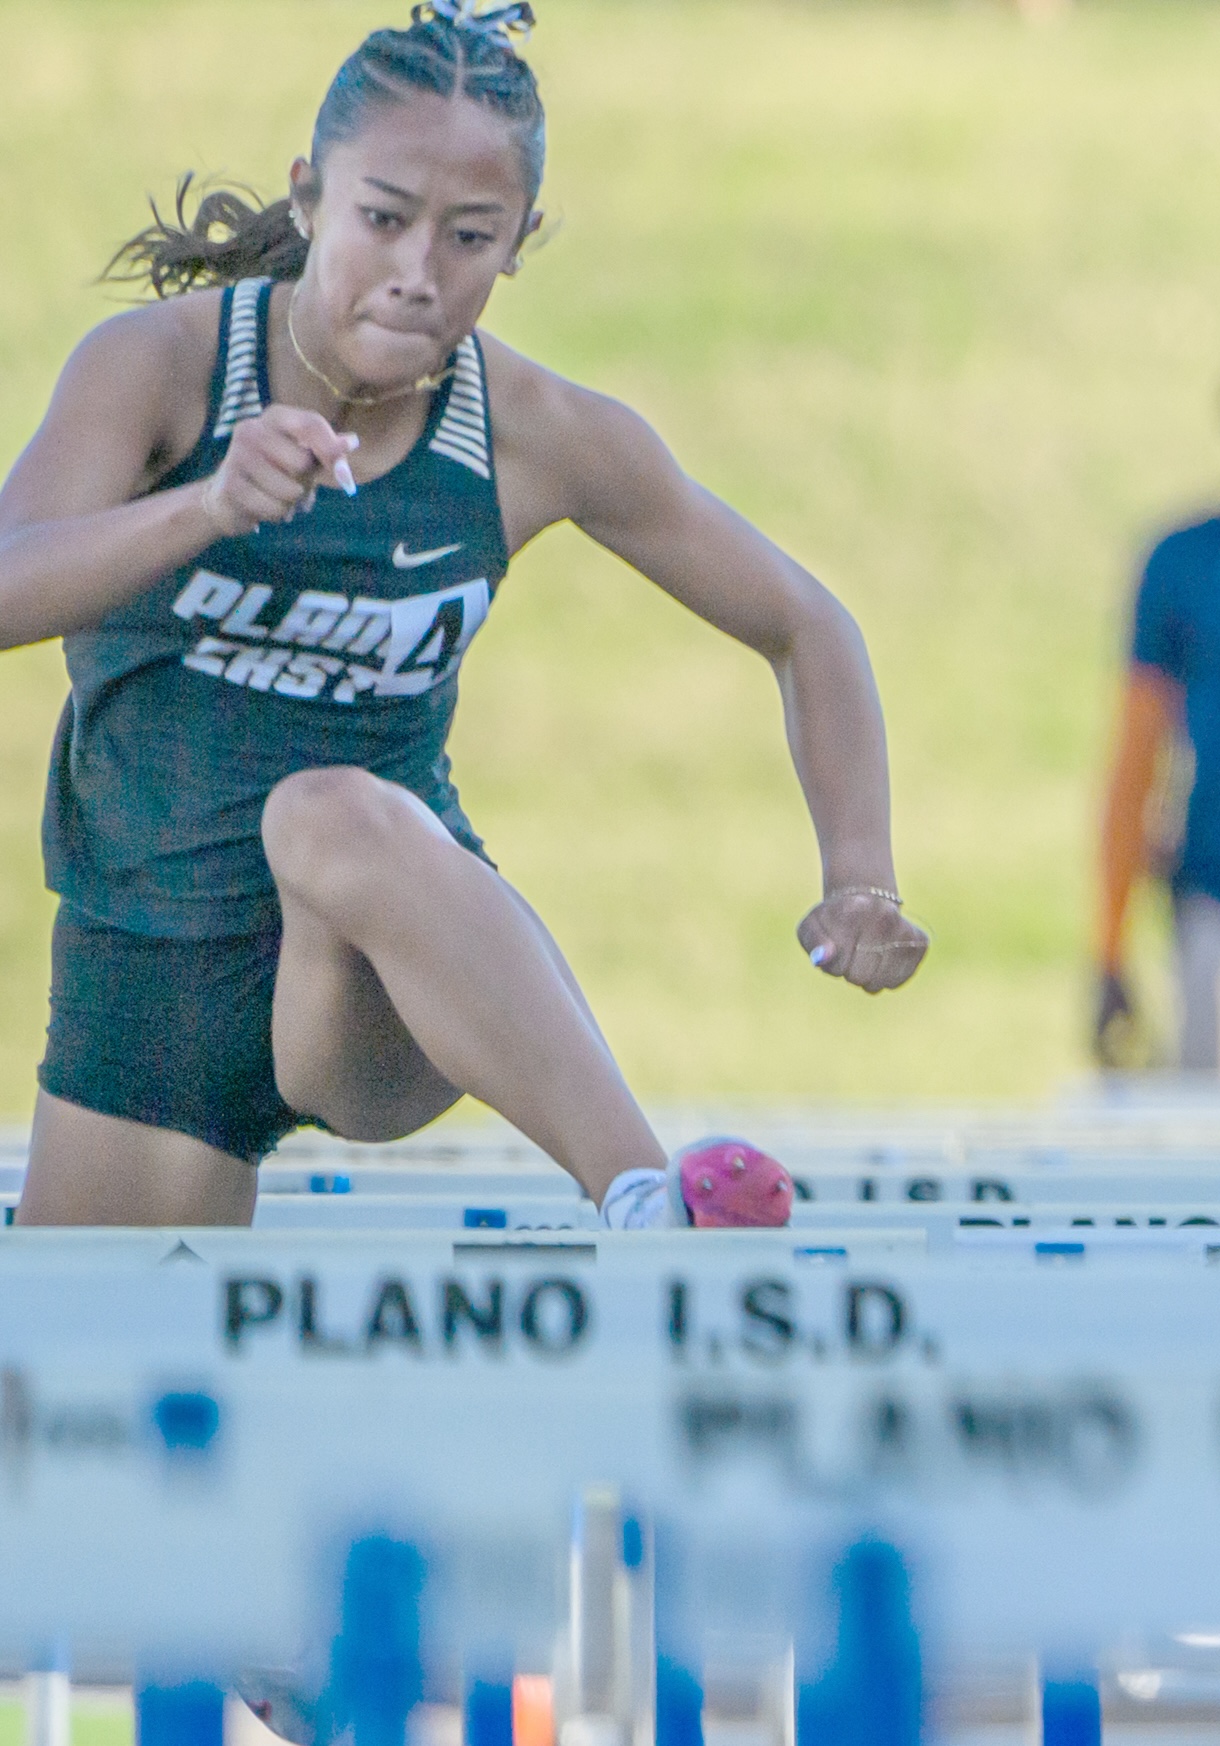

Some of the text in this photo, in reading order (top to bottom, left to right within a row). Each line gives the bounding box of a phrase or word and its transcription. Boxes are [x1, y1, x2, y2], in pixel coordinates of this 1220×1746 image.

[172, 568, 393, 656] PLAN
[394, 596, 466, 684] 4
[222, 1276, 942, 1366] PLANO I.S.D.
